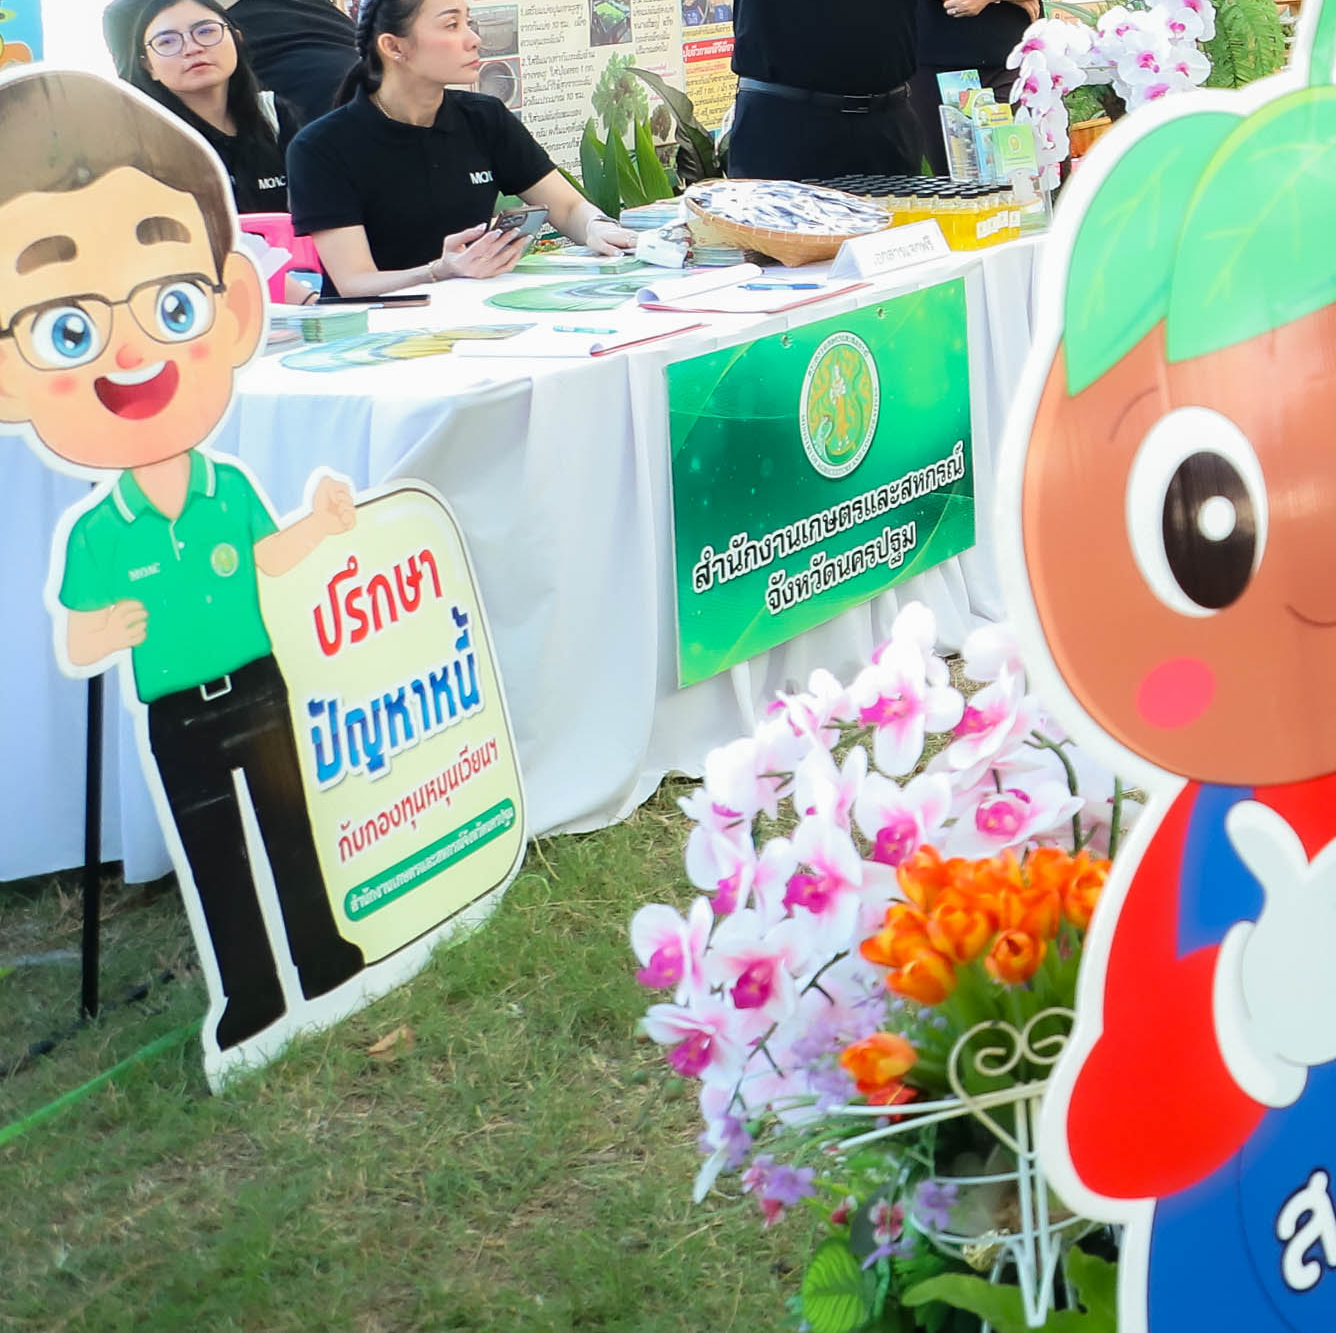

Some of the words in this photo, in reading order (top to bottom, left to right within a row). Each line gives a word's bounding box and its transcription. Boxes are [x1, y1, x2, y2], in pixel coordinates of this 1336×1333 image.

[694, 441, 964, 592] สำนักงานเกษตรและสหกรณ์
[766, 521, 917, 614] จังหวัดนครปฐม
[313, 549, 443, 657] ปรึกษา
[308, 606, 481, 784] ปัญหาหนี้
[338, 738, 499, 863] กับกองทุนหมุนเวียนฯ
